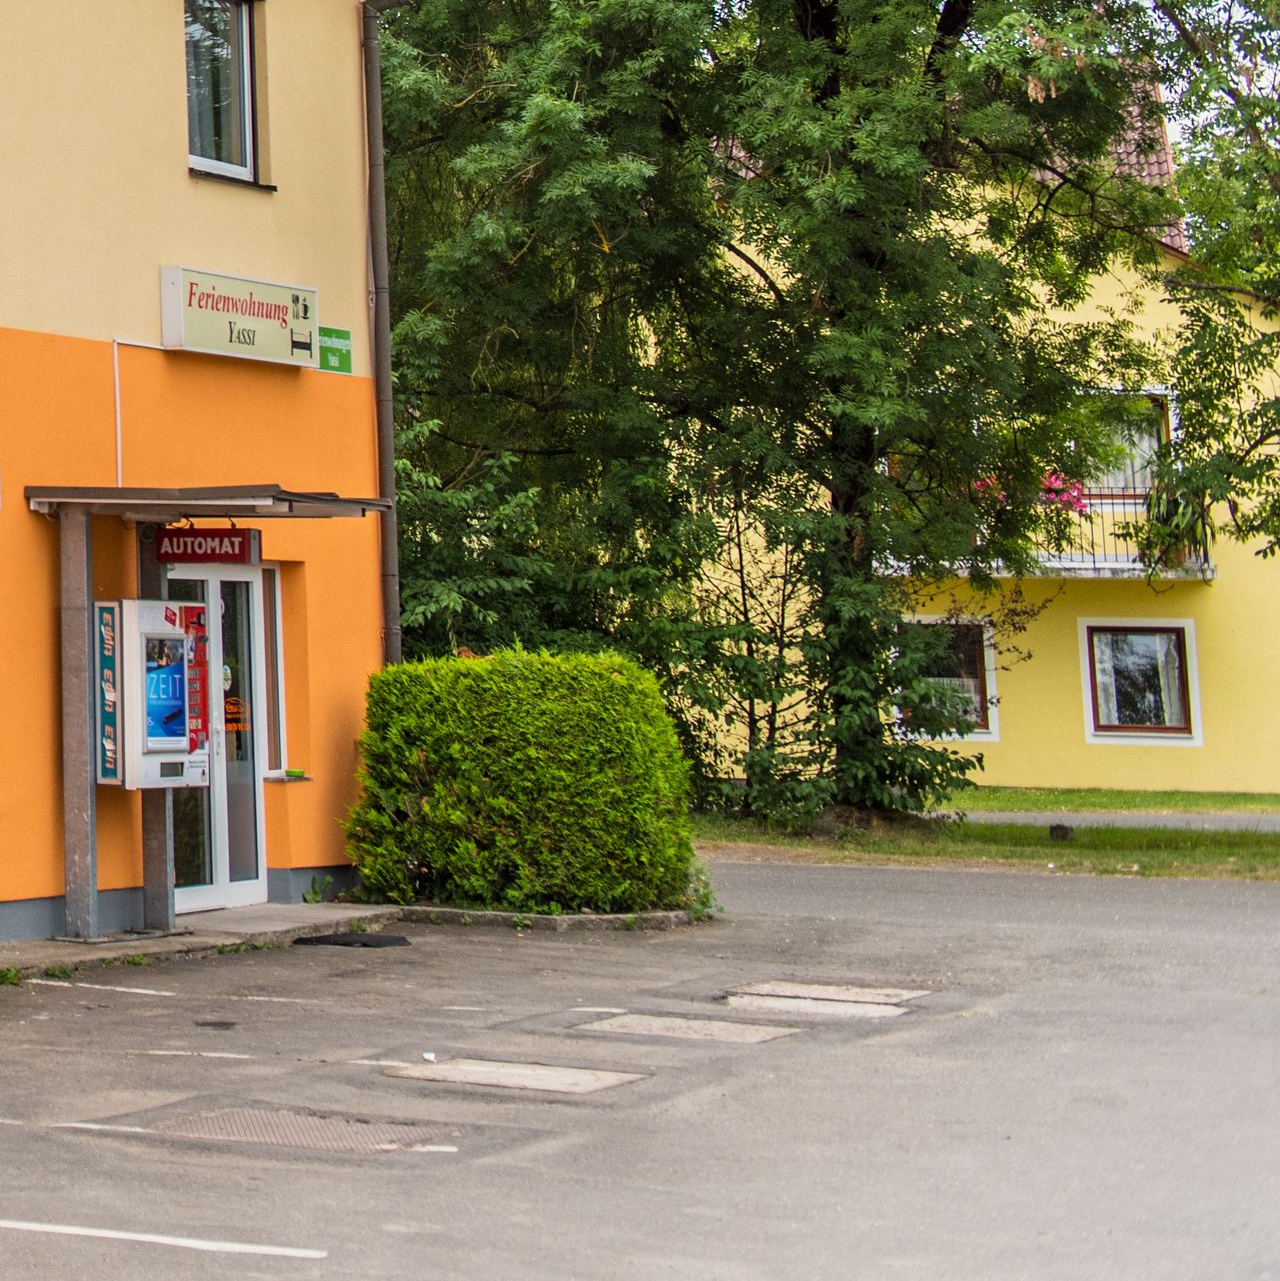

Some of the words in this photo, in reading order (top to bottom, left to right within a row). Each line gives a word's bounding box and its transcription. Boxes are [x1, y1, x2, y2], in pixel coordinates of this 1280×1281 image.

[187, 281, 289, 329] Ferienwohnung
[160, 537, 242, 555] AUTOMAT
[103, 667, 116, 713] tip3
[149, 674, 182, 698] ZEIT
